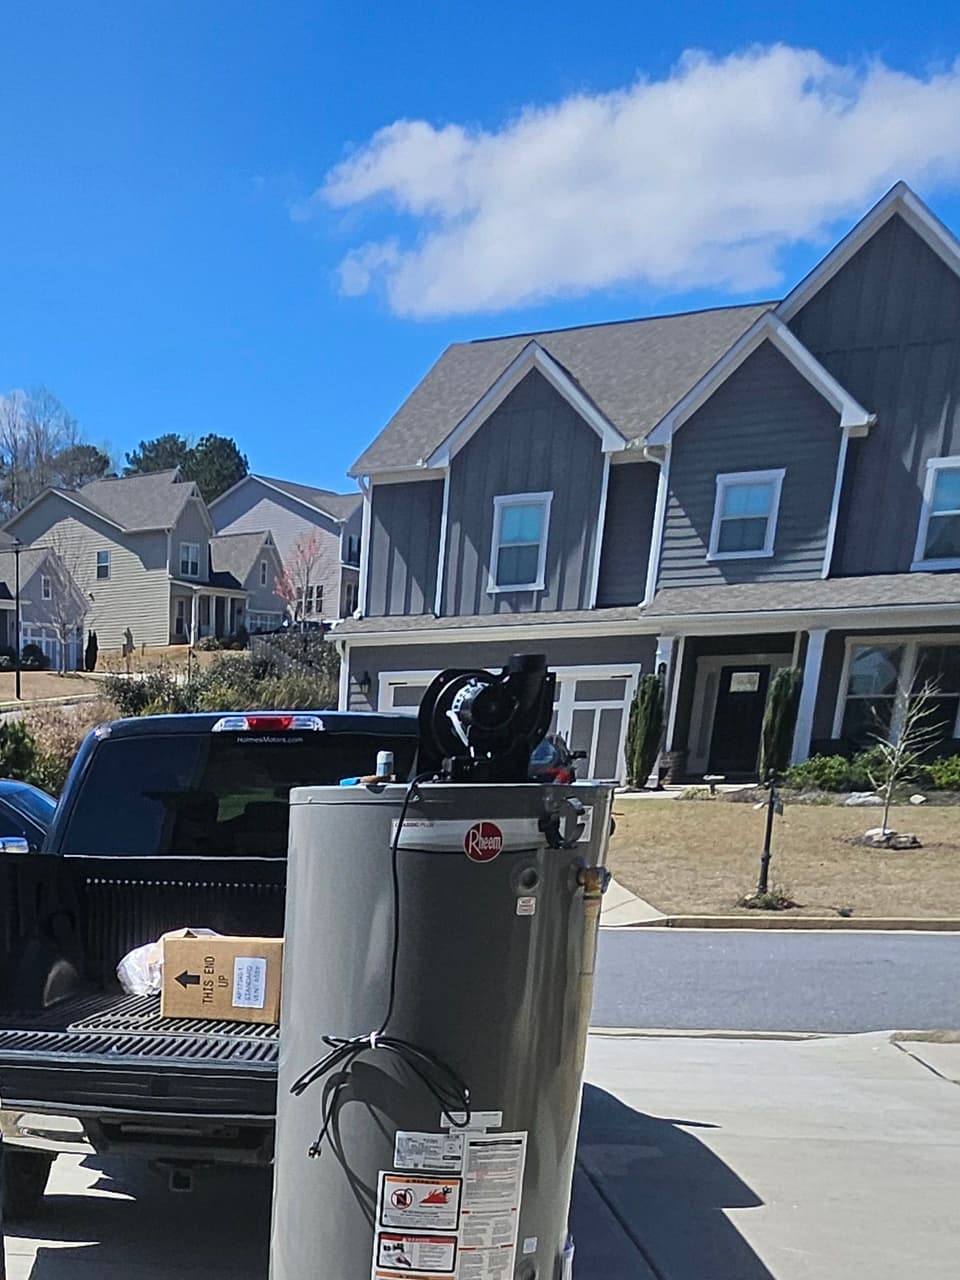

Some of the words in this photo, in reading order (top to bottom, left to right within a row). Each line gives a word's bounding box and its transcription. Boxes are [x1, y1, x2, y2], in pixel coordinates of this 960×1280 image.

[468, 822, 502, 855] Rheem
[204, 956, 216, 974] END
[202, 979, 214, 1004] THIS
[218, 975, 229, 988] UP
